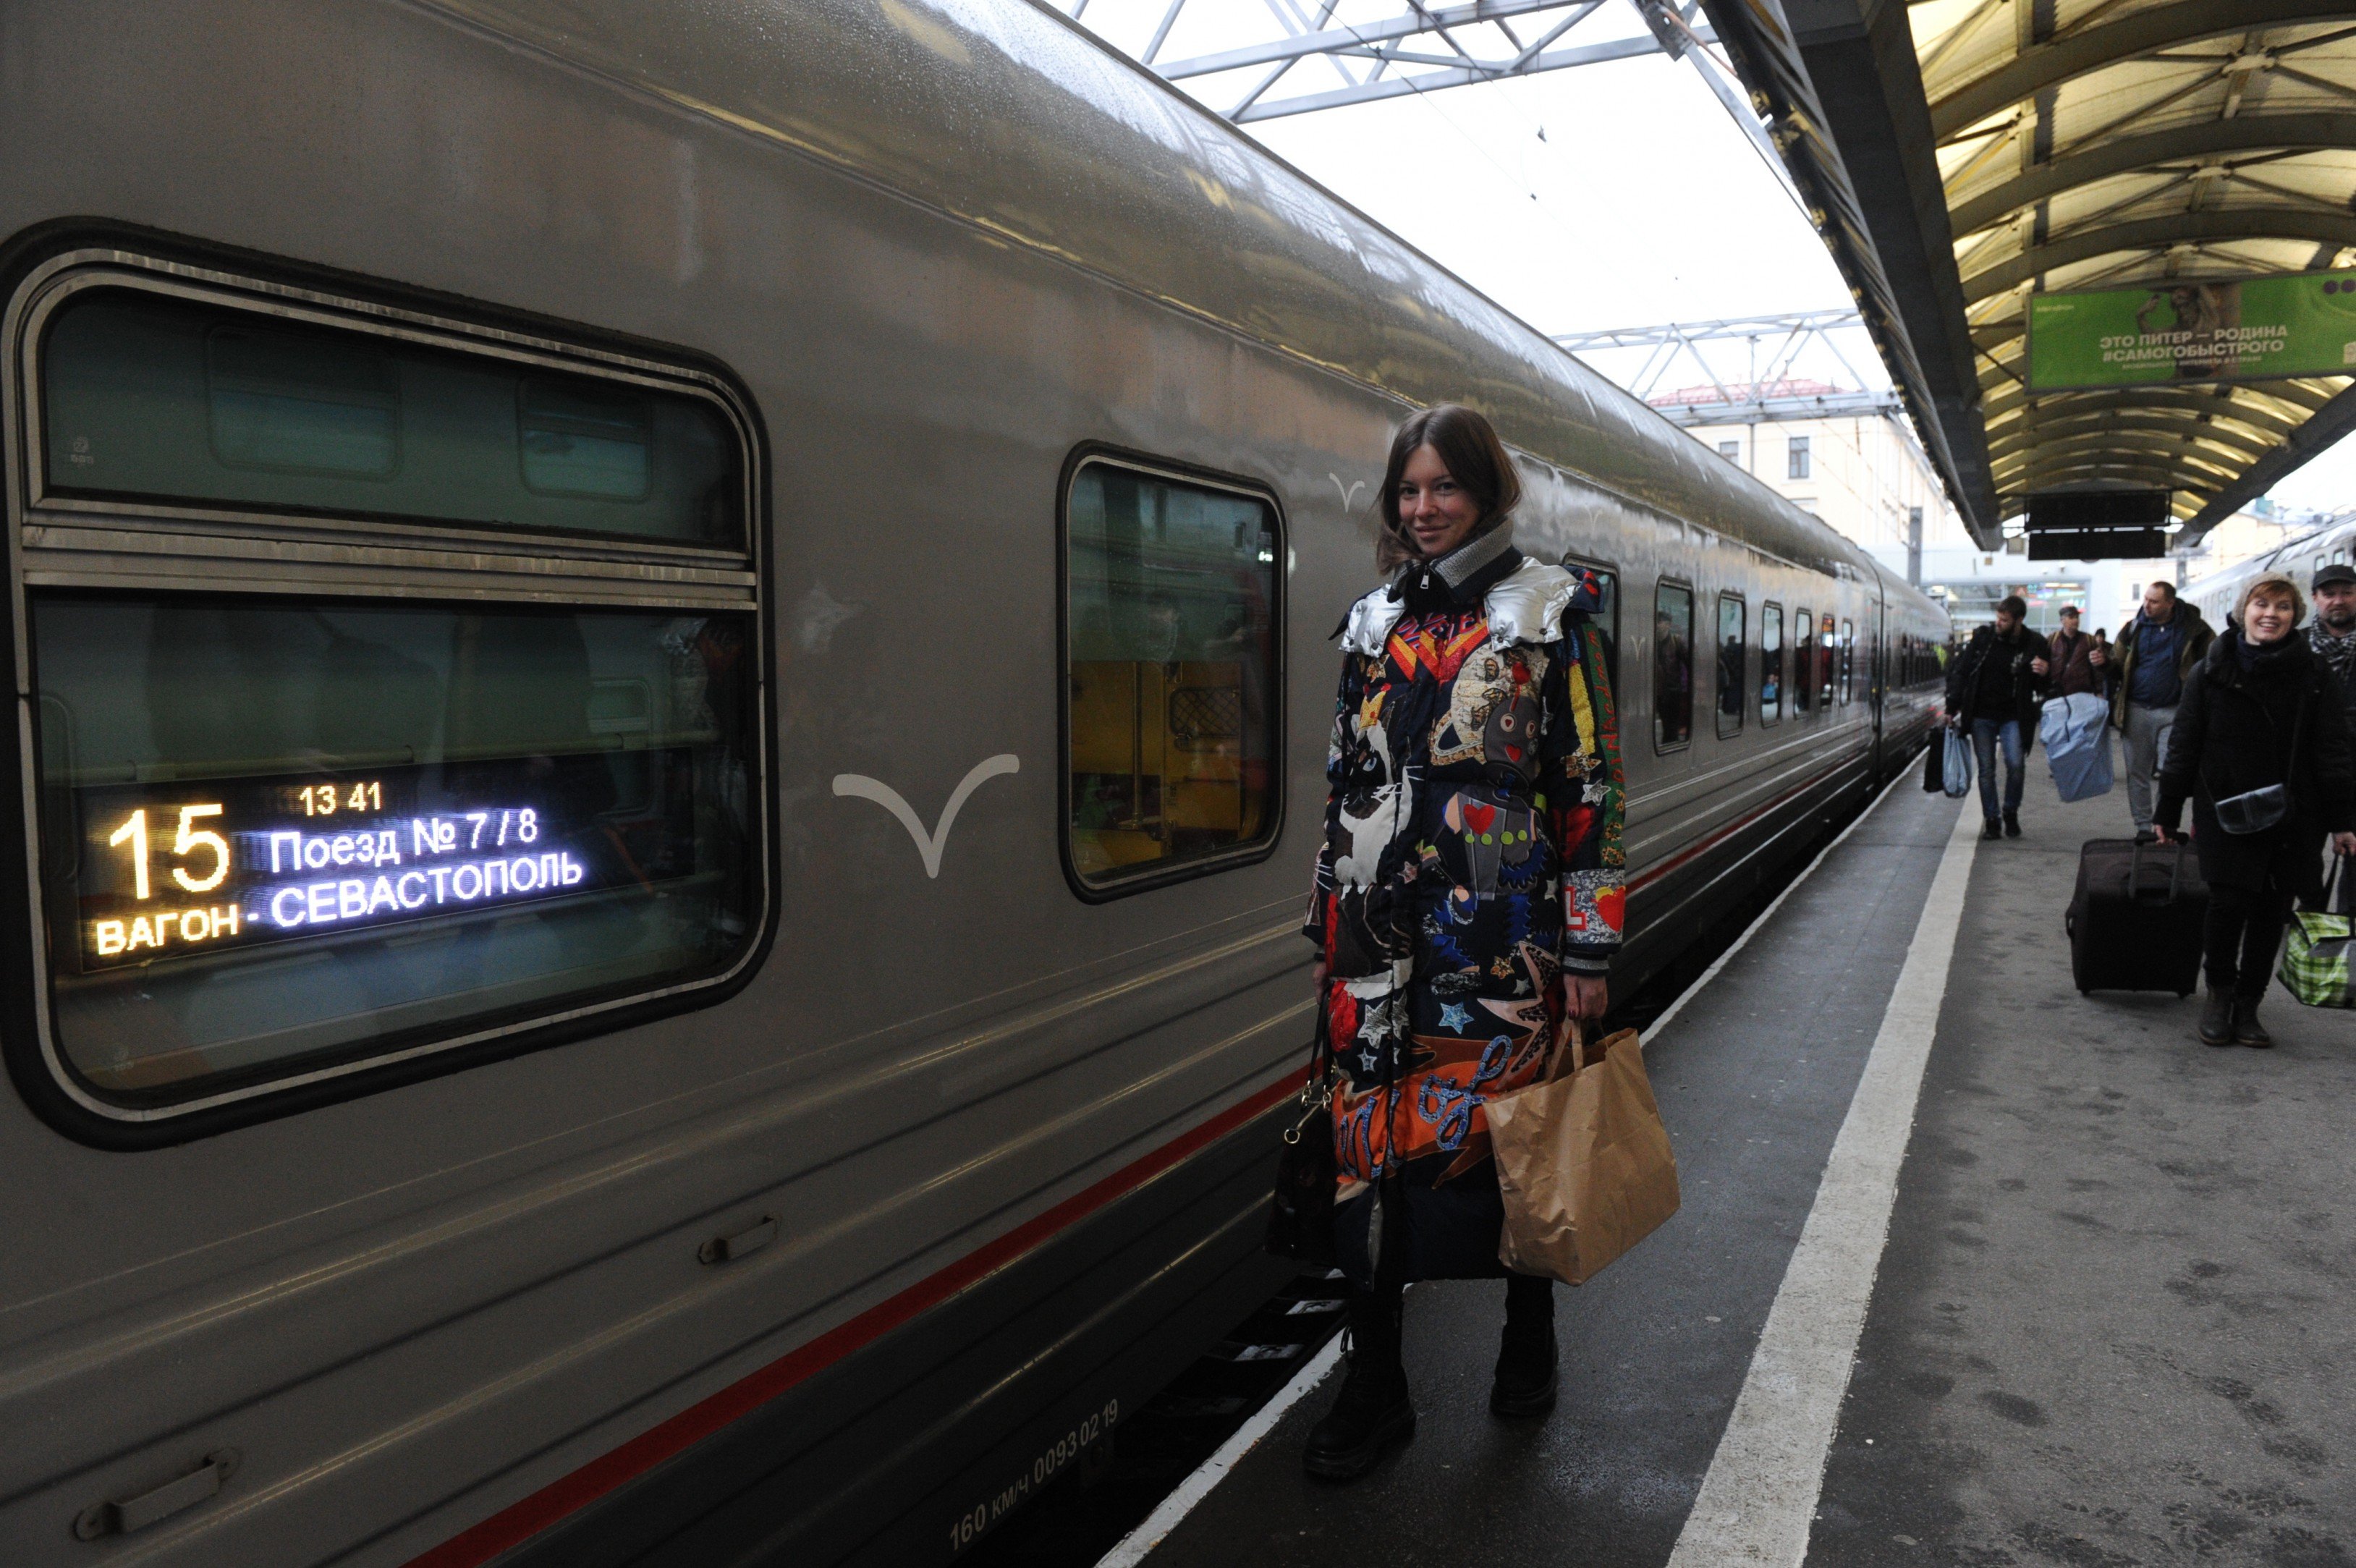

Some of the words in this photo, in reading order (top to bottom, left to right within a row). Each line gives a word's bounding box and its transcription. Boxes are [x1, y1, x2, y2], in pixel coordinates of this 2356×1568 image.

[2100, 335, 2135, 349] ЭТО
[2139, 330, 2192, 347] ПИТЕР
[2213, 325, 2288, 342] РОДИНА
[2103, 339, 2285, 363] #САМОГОБЫСТРОГО
[300, 785, 337, 816] 13
[347, 781, 381, 811] 41
[110, 803, 230, 899] 15
[271, 831, 401, 873] Поезд
[413, 818, 457, 857] №
[271, 852, 584, 928] СЕВАСТОПОЛЬ
[96, 904, 239, 956] ВАГОН
[949, 1504, 986, 1551] 160
[992, 1474, 1029, 1520] КМ/Ч
[1034, 1431, 1077, 1484] 0093
[1080, 1412, 1099, 1446] 02
[1101, 1398, 1118, 1428] 19
